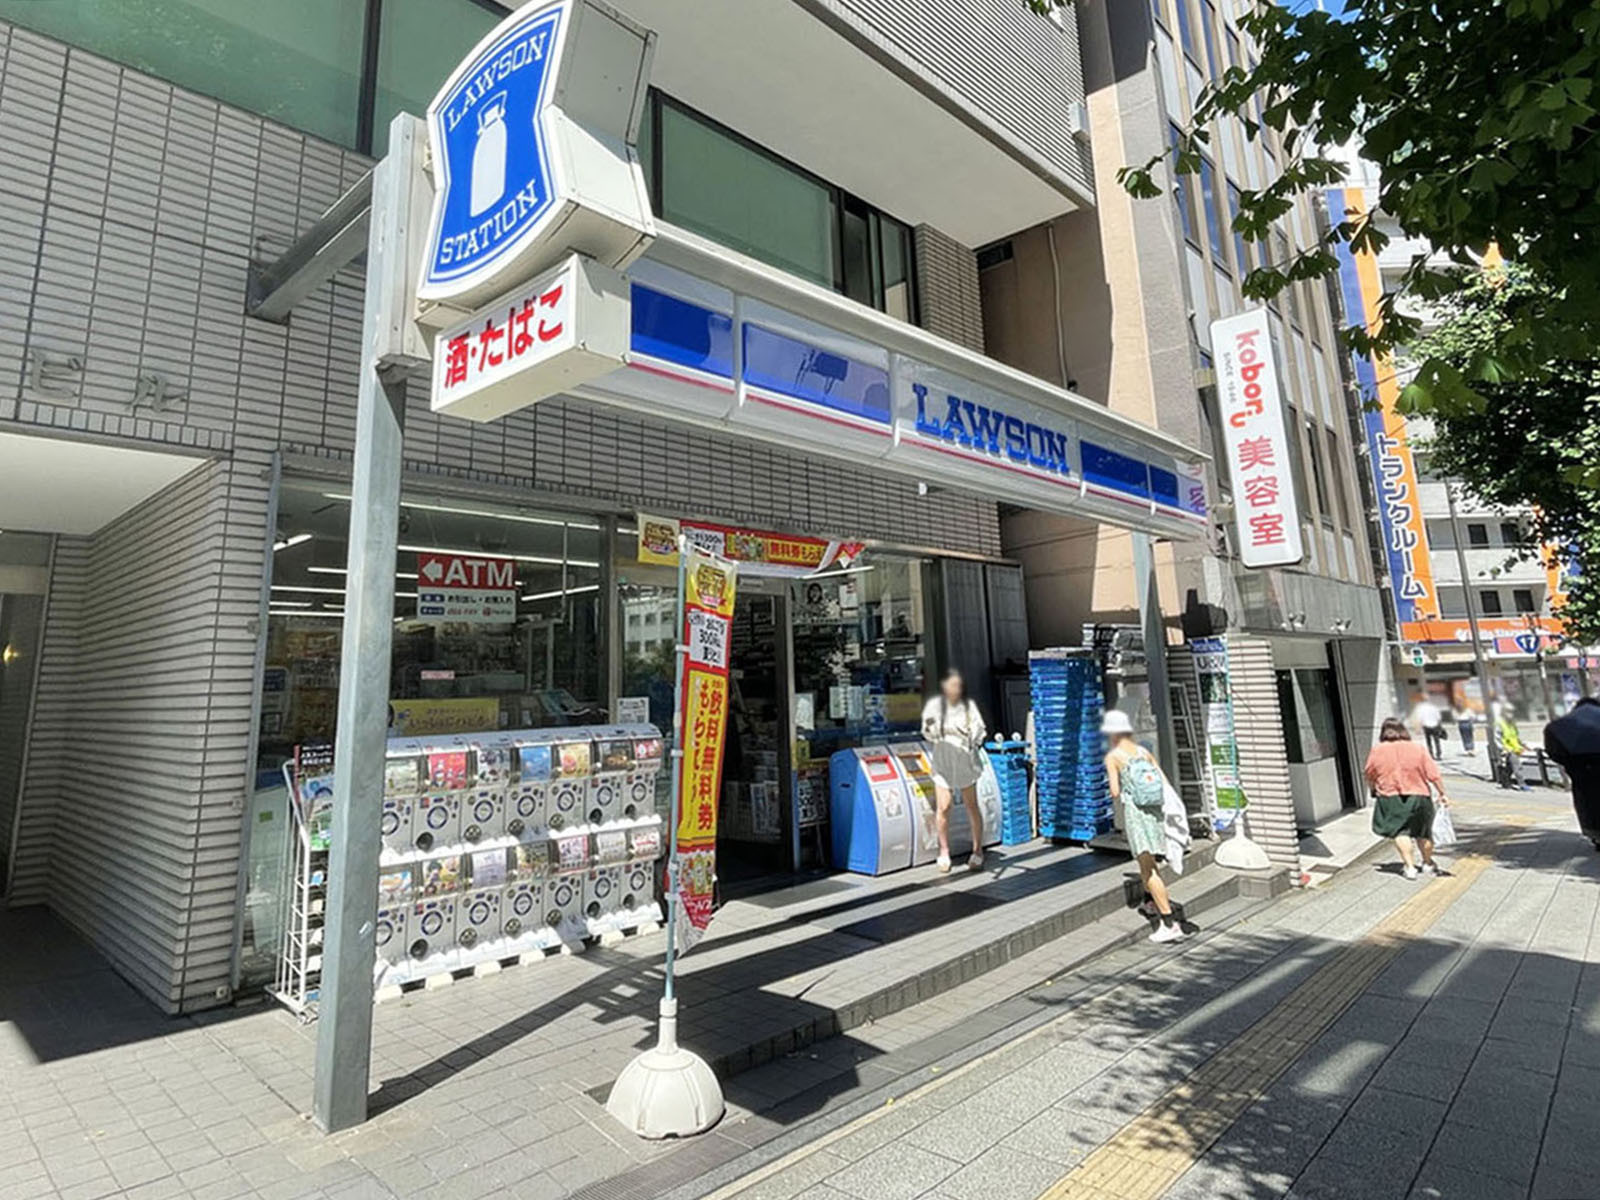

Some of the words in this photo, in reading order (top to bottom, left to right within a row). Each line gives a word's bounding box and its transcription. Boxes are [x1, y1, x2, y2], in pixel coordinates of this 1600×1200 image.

[447, 31, 547, 133] LAWSON
[440, 179, 539, 266] STATION
[444, 285, 564, 389] 酒・たばこ
[912, 383, 1070, 475] LAWSON
[1237, 435, 1286, 547] 美容室
[1377, 434, 1426, 599] トランクルーム
[444, 558, 513, 587] ATM
[1520, 637, 1536, 649] 17
